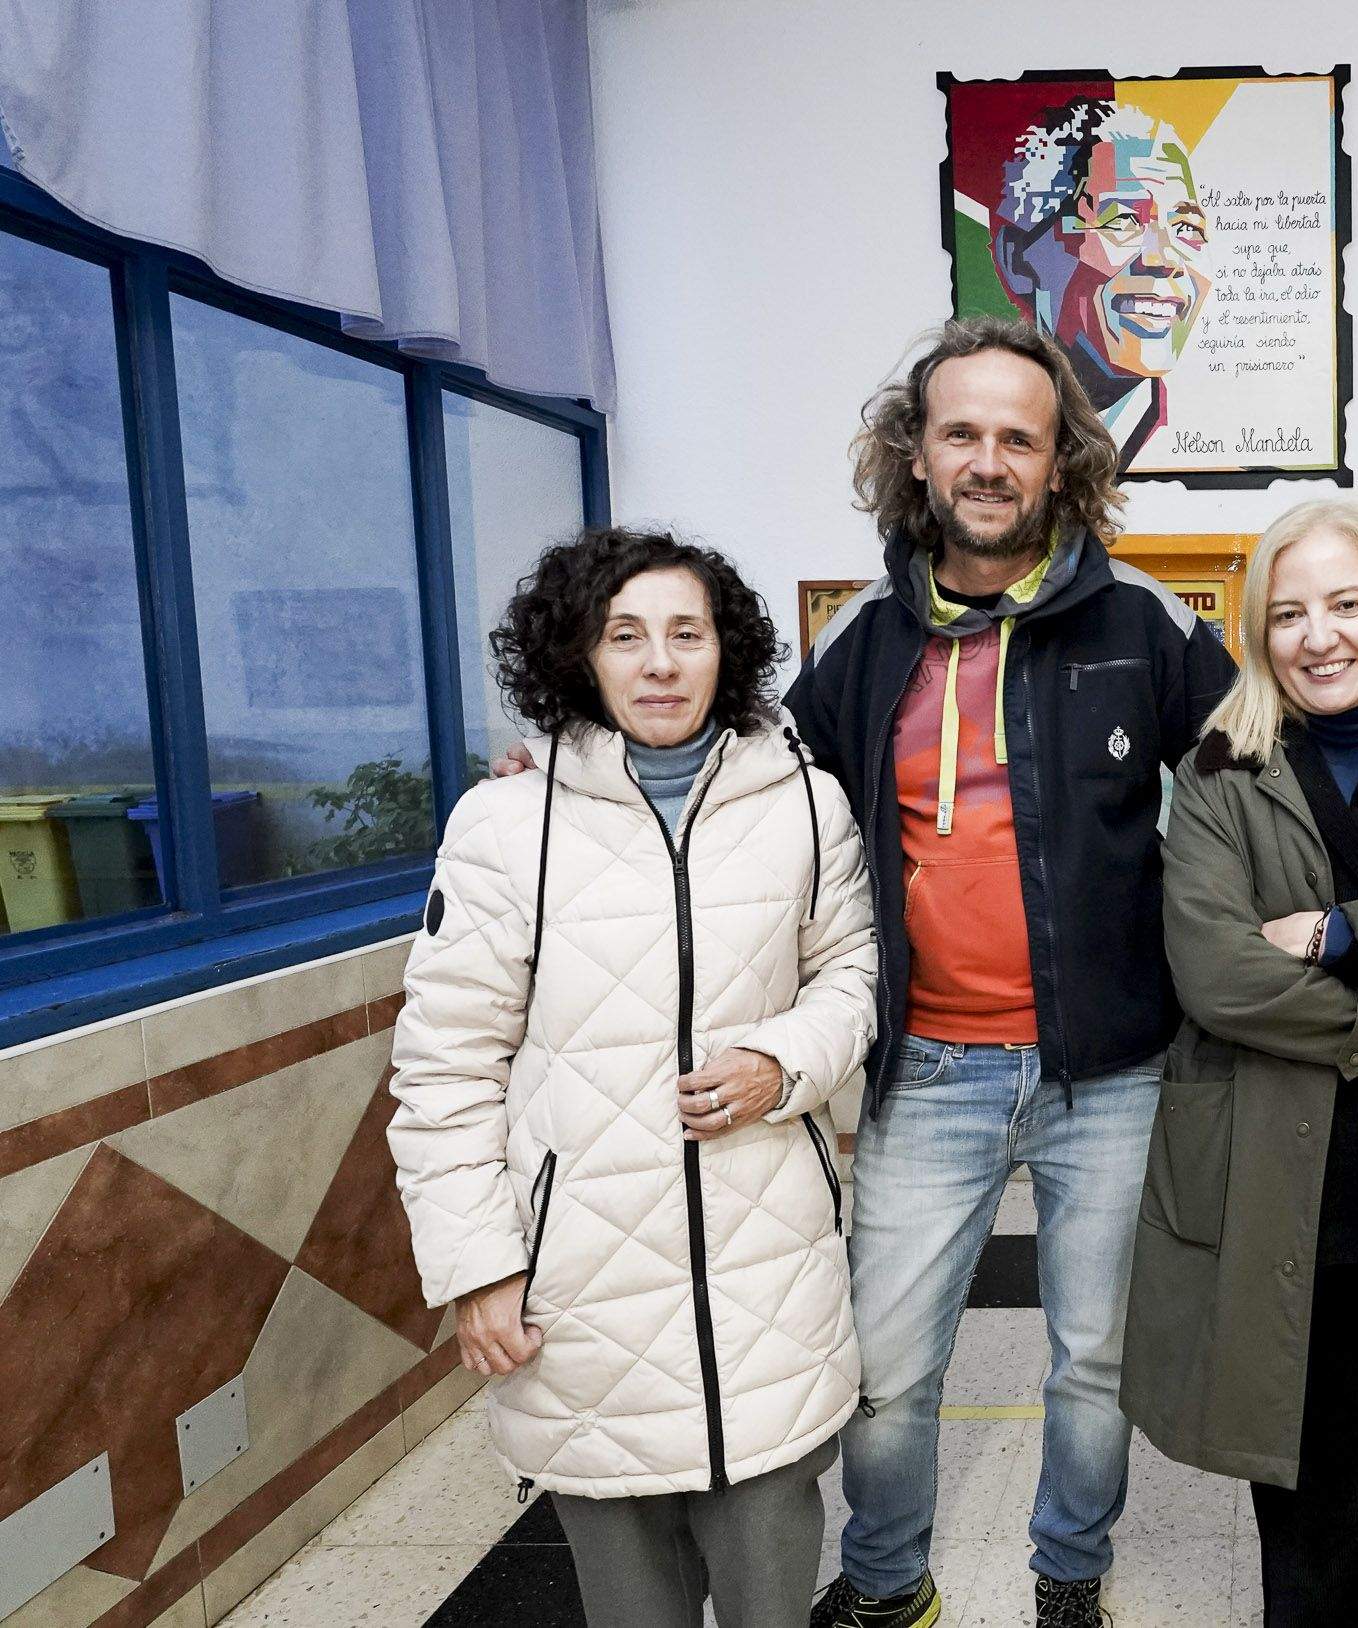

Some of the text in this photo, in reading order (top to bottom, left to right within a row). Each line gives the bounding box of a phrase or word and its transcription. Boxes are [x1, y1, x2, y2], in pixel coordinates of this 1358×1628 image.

[1223, 191, 1252, 206] salir
[1255, 197, 1275, 211] por
[1277, 190, 1289, 206] la
[1291, 190, 1327, 211] puerta
[1215, 212, 1321, 230] hacia mi libertad
[1232, 243, 1291, 262] supe que,
[1216, 262, 1322, 284] si no dejaba atrás
[1215, 284, 1320, 302] toda la ira, el odio
[1202, 309, 1310, 334] y el resentimiento,
[1198, 331, 1296, 354] seguiría siendo
[1209, 362, 1226, 372] un
[1171, 426, 1314, 454] Nelson Mandela
